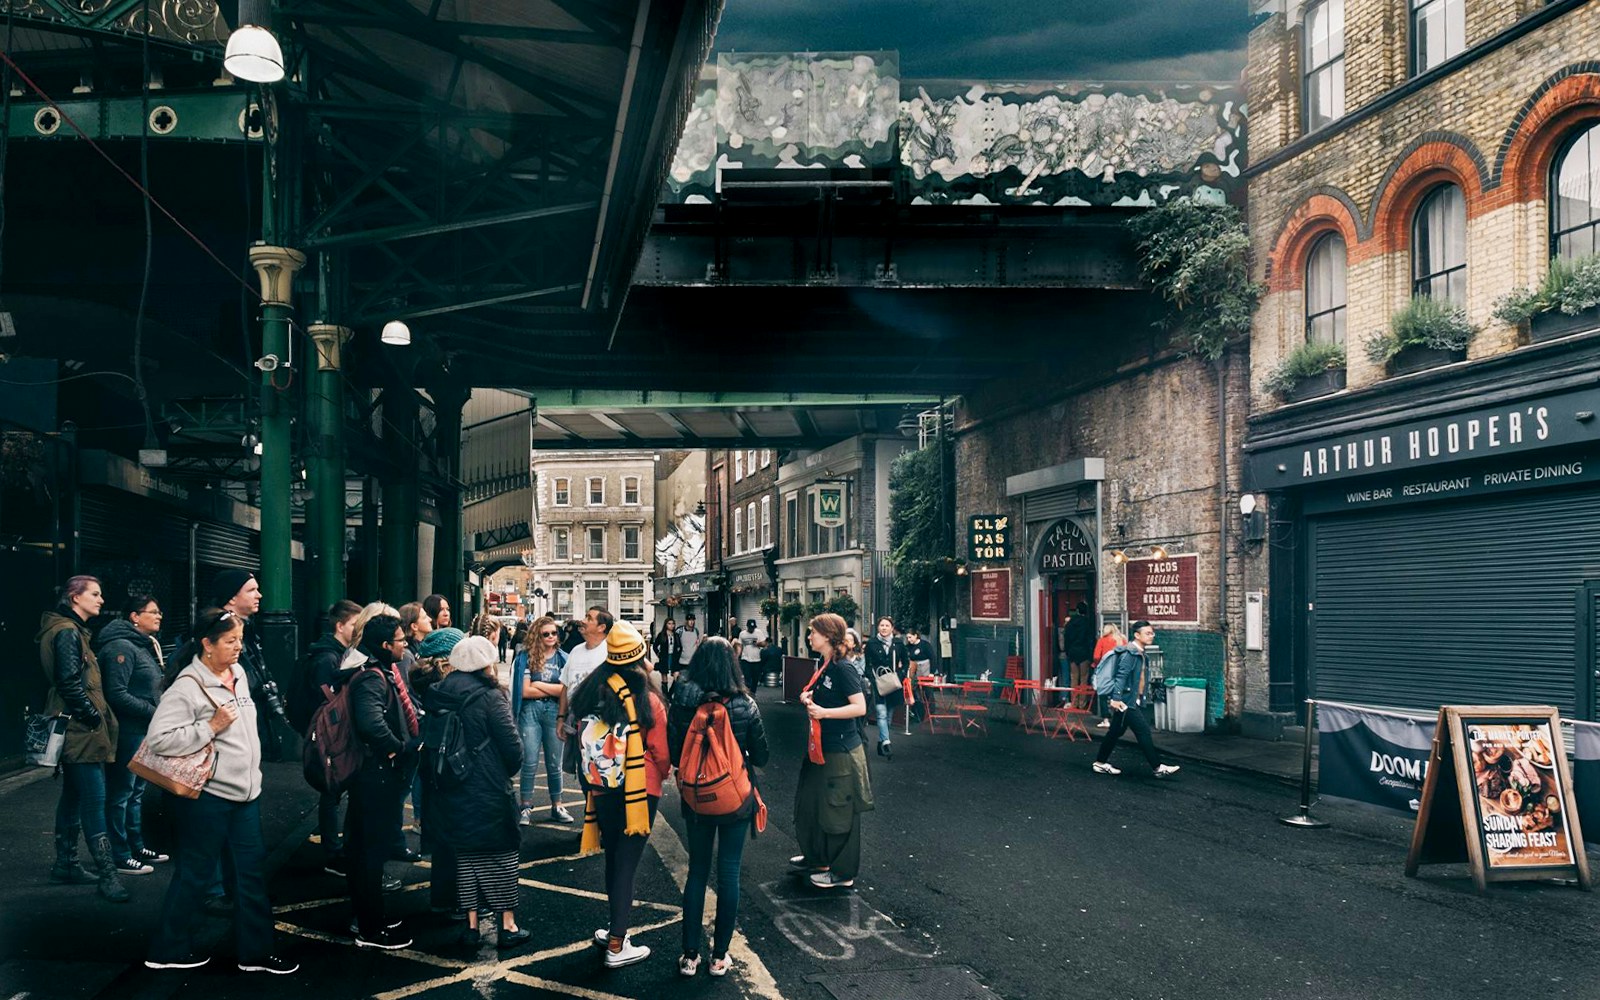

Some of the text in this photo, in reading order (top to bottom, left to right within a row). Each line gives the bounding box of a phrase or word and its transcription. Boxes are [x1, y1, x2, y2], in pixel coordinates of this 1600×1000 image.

[1302, 406, 1549, 477] ARTHUR HOOPER'S
[1347, 461, 1583, 503] WINE BAR RESTAURANT PRIVATE DINING
[820, 495, 840, 512] W
[974, 519, 994, 531] EL
[974, 533, 1005, 545] PAS
[1060, 538, 1074, 552] EL
[1042, 551, 1093, 568] PASTOR
[1147, 561, 1178, 574] TACOS
[1145, 573, 1180, 586] TOSTADAS
[1146, 604, 1179, 616] MEZCAL
[1473, 730, 1488, 741] THE
[1370, 750, 1421, 781] DOOM
[1482, 815, 1523, 831] SUNDAY
[1485, 832, 1558, 848] SHARING FEAST
